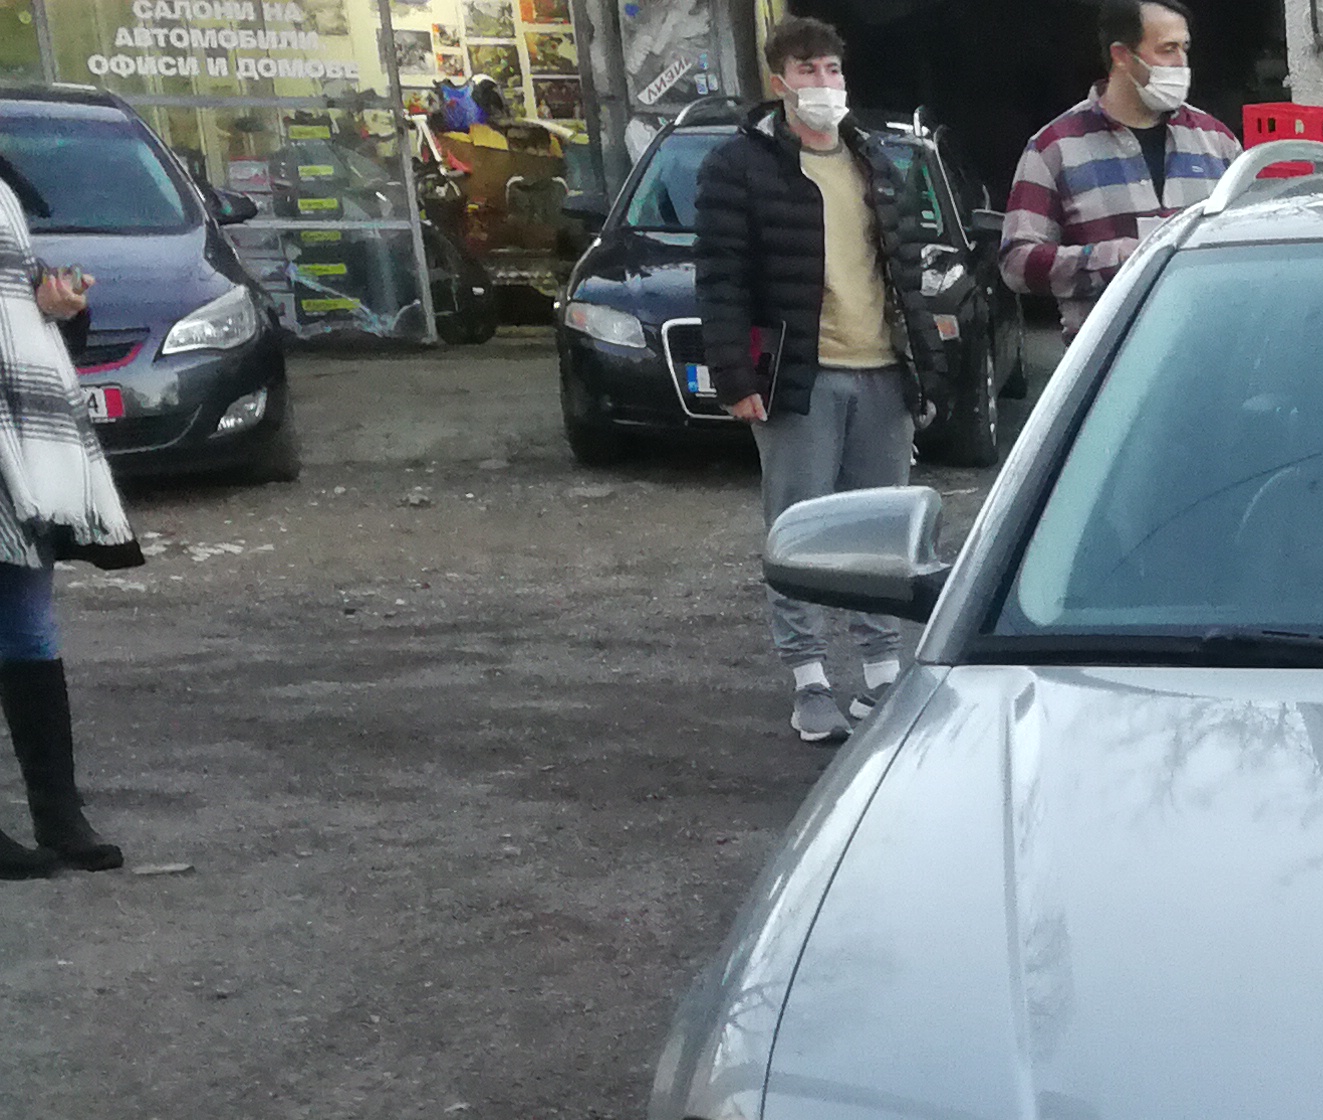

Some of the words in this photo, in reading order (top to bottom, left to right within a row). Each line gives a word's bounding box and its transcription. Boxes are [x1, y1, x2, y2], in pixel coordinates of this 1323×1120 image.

[132, 0, 255, 20] САЛОНИ
[262, 2, 306, 21] НА
[87, 54, 200, 78] ОФИСИ
[207, 57, 229, 77] И
[236, 58, 359, 80] ДОМОВЕ
